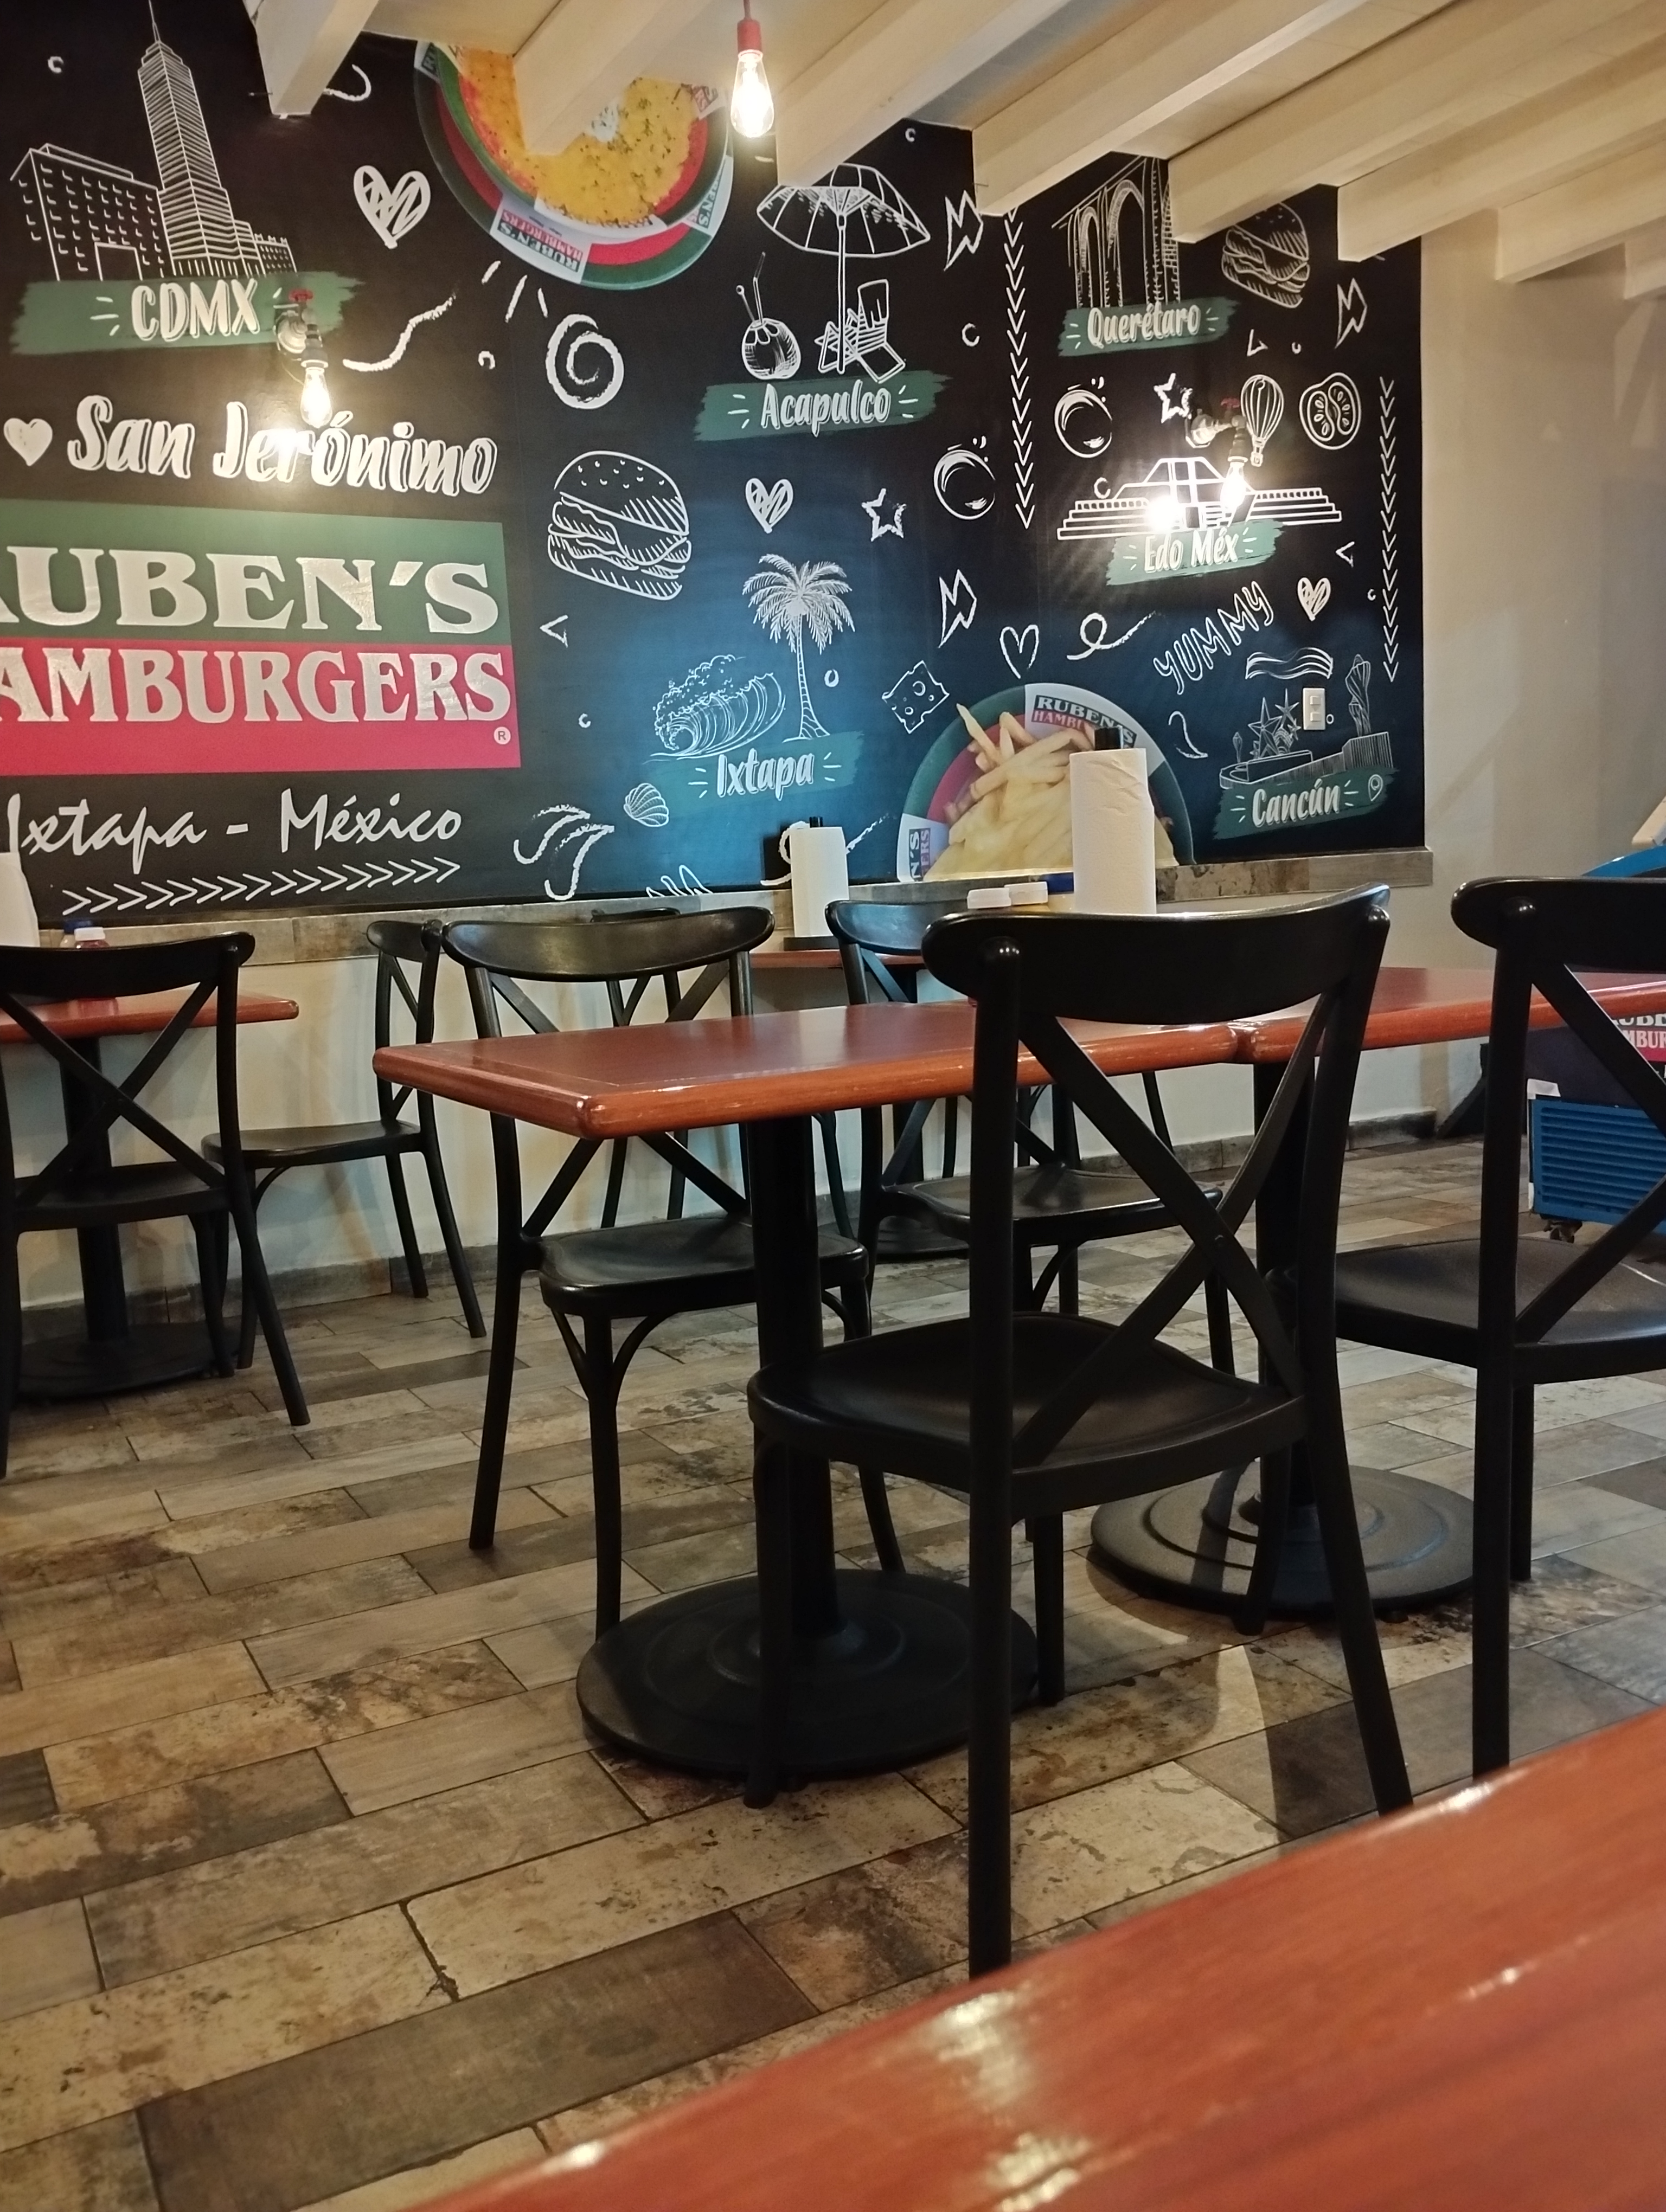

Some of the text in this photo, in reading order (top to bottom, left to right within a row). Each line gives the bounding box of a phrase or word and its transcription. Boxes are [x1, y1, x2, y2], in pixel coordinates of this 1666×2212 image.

[500, 221, 579, 272] RUBEN'S
[131, 279, 260, 340] CDMX
[1087, 305, 1201, 349] Querétaro
[760, 380, 893, 437] Acapulco
[67, 395, 498, 497] San Jerónimo
[1144, 526, 1239, 573] Edo Méx
[0, 545, 499, 633] UBEN'S
[1154, 581, 1273, 695] YUMMY
[0, 647, 511, 723] AMBURGERS
[716, 748, 815, 801] Ixtapa
[1252, 779, 1341, 827] Cancún
[7, 793, 207, 874] Ixtapa
[280, 788, 462, 853] México
